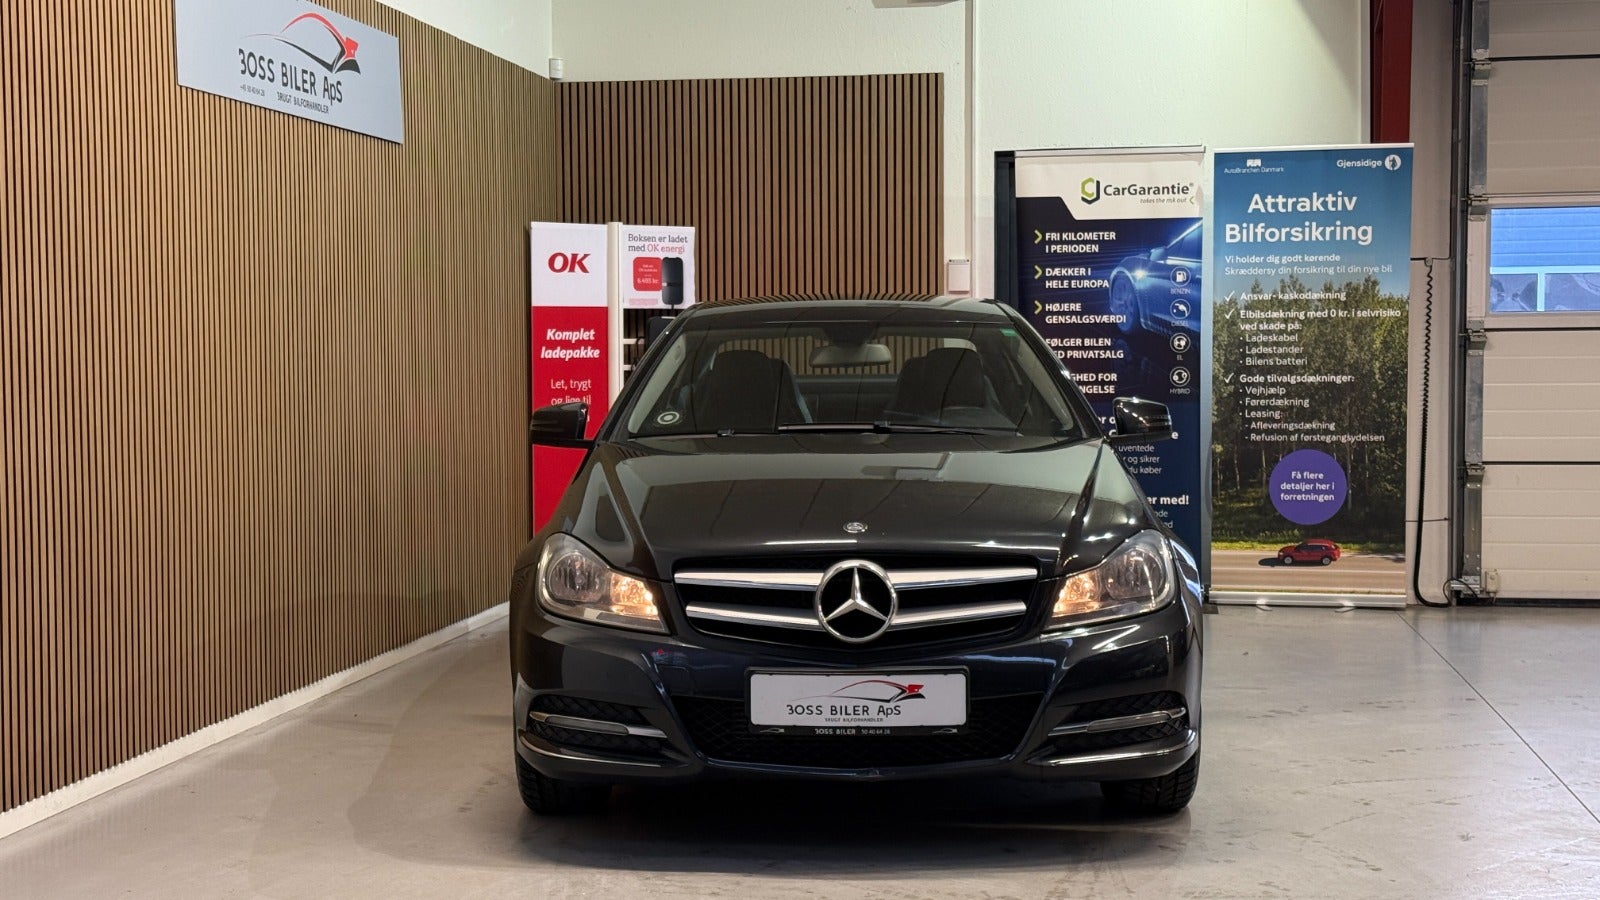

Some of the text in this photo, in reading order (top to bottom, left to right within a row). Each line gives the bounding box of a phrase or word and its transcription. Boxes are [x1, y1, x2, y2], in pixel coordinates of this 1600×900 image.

[281, 62, 316, 96] BILER
[323, 76, 342, 105] ApS
[1336, 159, 1382, 168] Gjensidige
[1248, 191, 1358, 213] Attraktiv
[1046, 232, 1116, 241] FRI KILOMETER
[1225, 220, 1372, 246] Bilforsikring
[628, 234, 656, 242] Boksen
[668, 235, 688, 243] ladet
[648, 244, 660, 252] OK
[660, 246, 684, 254] energi
[1051, 244, 1099, 253] PERIODEN
[548, 252, 591, 273] OK
[1266, 256, 1280, 264] dig
[1282, 255, 1303, 264] godt
[1304, 254, 1340, 262] kørende
[1046, 268, 1086, 276] DÆKKER
[1225, 266, 1276, 276] Skræddersy
[1294, 266, 1334, 274] forsikring
[1364, 266, 1378, 275] nye
[1046, 280, 1110, 288] HELE EUROPA
[1240, 292, 1346, 300] Ansvar- kaskodækning
[1046, 303, 1082, 312] HØJERE
[1240, 310, 1305, 320] Elbilsdækning
[1307, 310, 1327, 318] med
[1330, 310, 1336, 318] 0
[1338, 310, 1350, 318] kr.
[1357, 308, 1401, 318] selvrisiko
[1046, 315, 1126, 324] GENSALGSVÆRDI
[1288, 322, 1302, 332] på:
[546, 329, 595, 342] Komplet
[1246, 334, 1298, 342] Ladeskabel
[1046, 338, 1111, 346] FØLGER BILEN
[541, 347, 600, 361] ladepakke
[1067, 350, 1124, 359] PRIVATSALG
[1246, 358, 1274, 366] Bilens
[1098, 374, 1118, 382] FOR
[1267, 374, 1355, 384] tilvalgsdækninger:
[551, 379, 592, 391] Let, trygt
[1246, 386, 1286, 396] Vejhjælp
[1246, 398, 1310, 408] Førerdækning
[1250, 422, 1336, 431] Afleveringsdækning
[1250, 434, 1384, 443] Refusion af førstegangsydelsen
[1292, 471, 1302, 480] Få
[1280, 482, 1314, 492] detaljer
[1160, 495, 1189, 504] med!
[1280, 493, 1334, 502] forretningen
[830, 705, 870, 716] BILER
[877, 705, 902, 718] ApS
